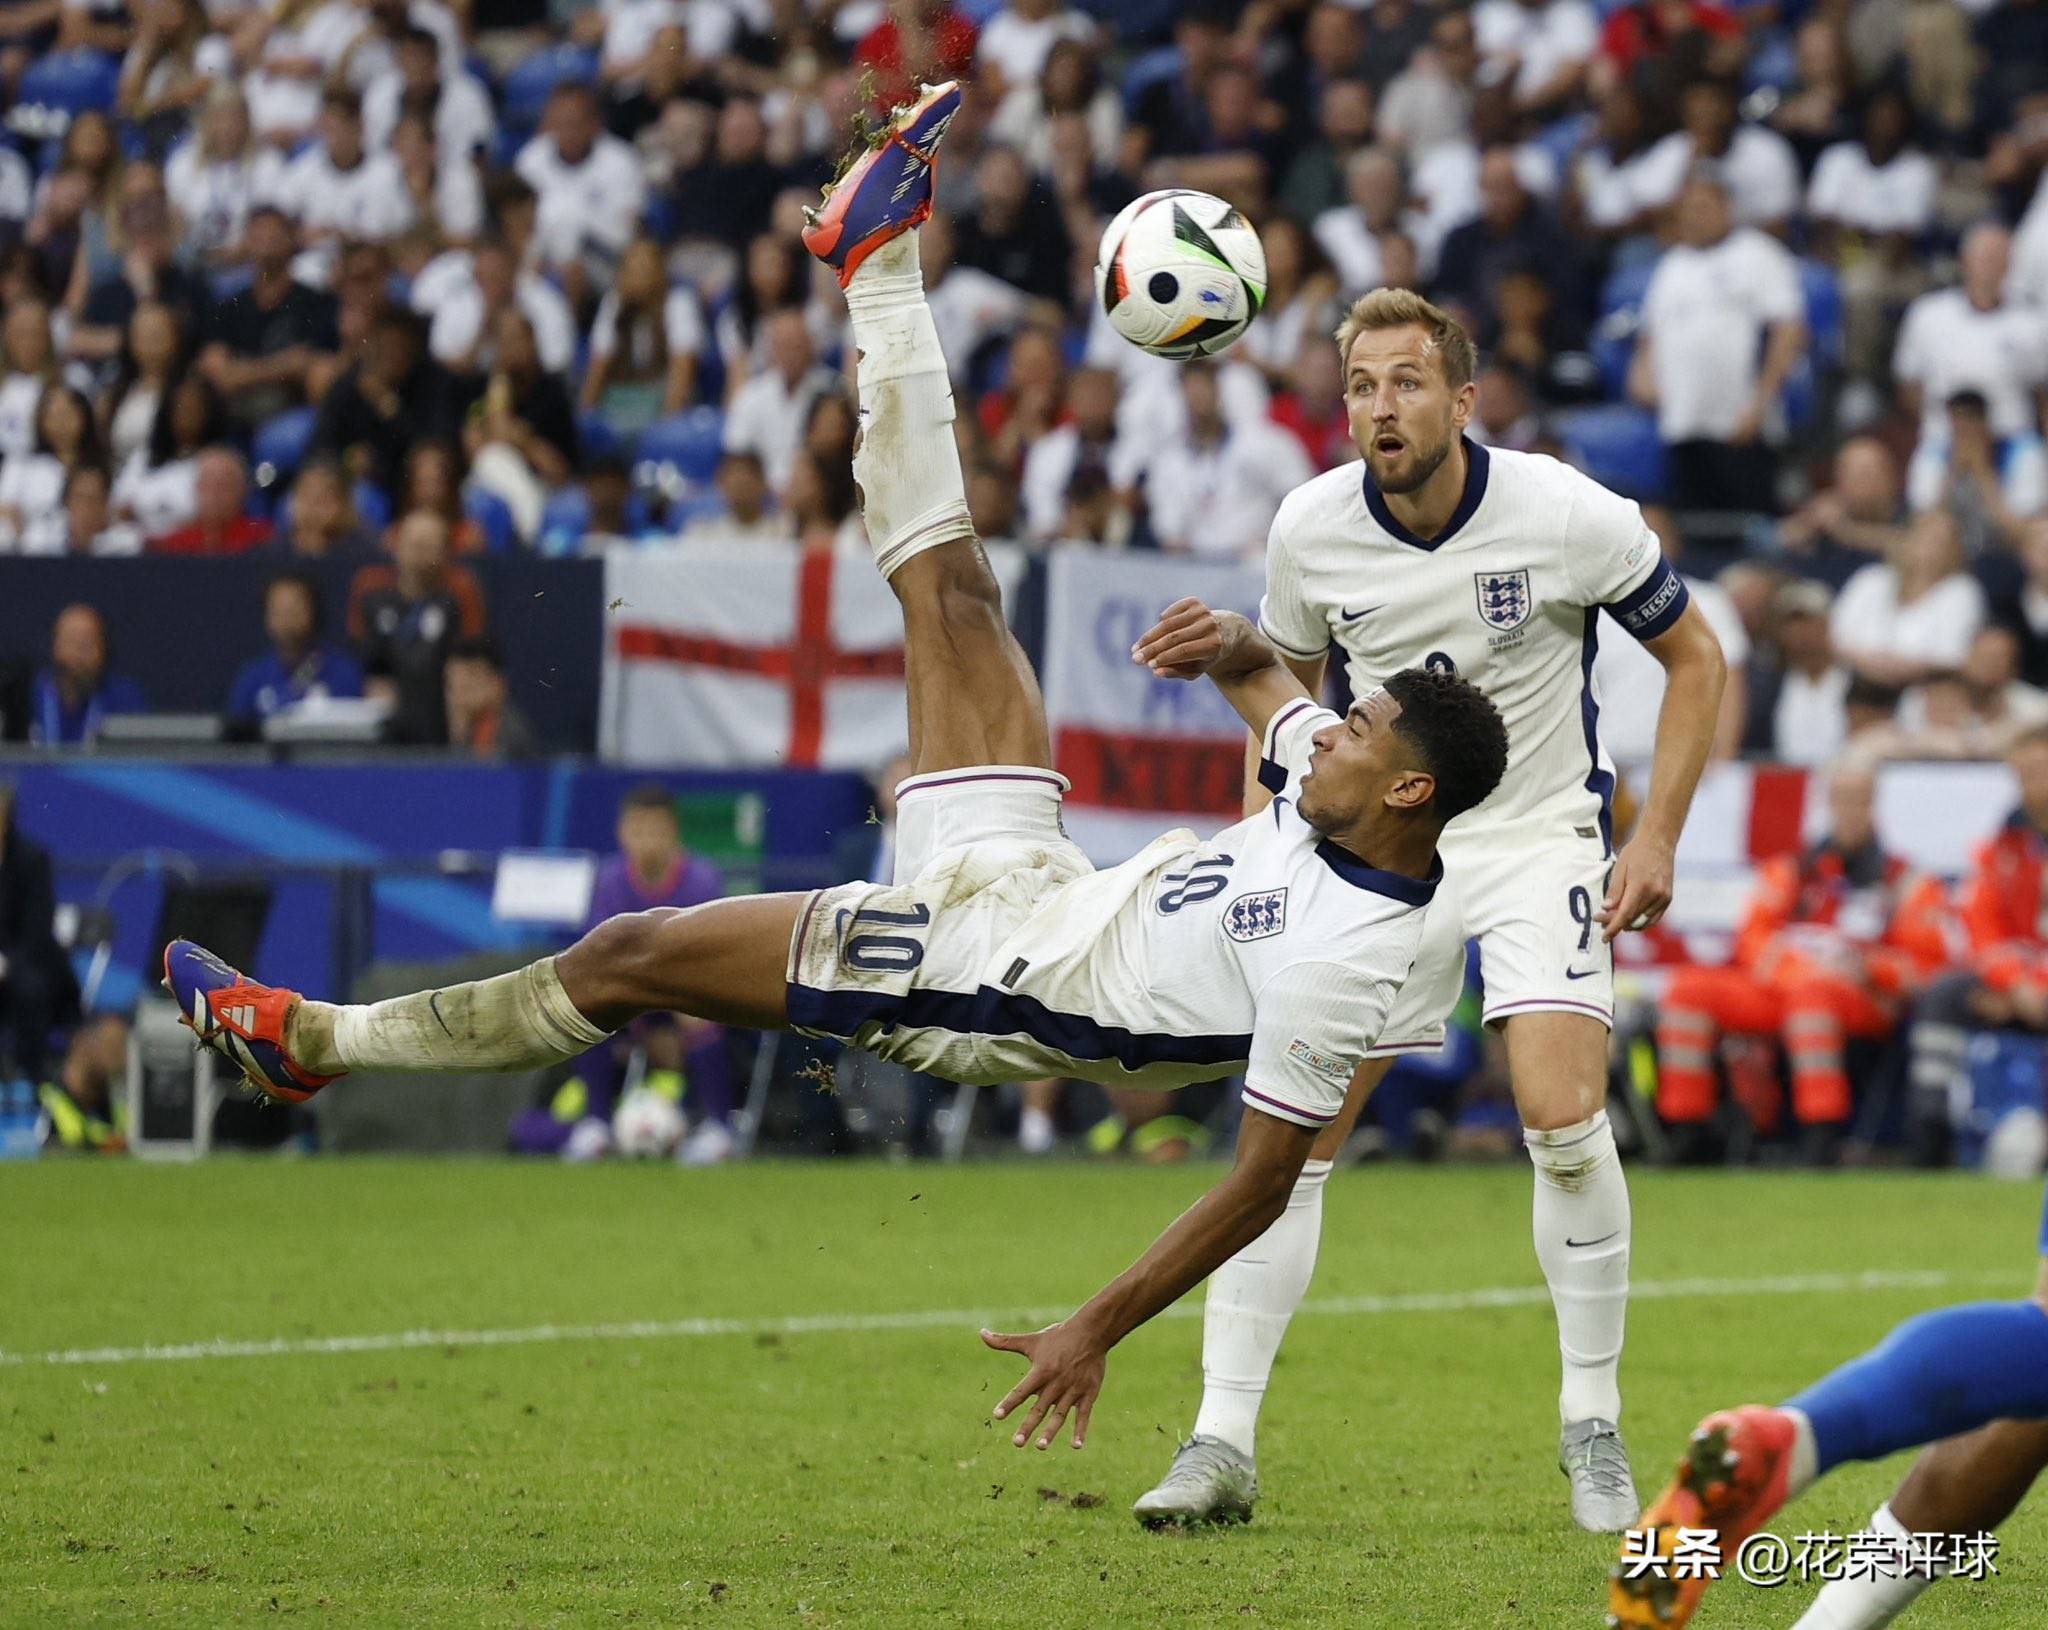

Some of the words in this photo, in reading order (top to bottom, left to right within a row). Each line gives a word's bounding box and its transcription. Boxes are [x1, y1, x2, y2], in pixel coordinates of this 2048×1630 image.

[1641, 573, 1679, 619] RESPECT
[1156, 854, 1234, 916] 10
[845, 903, 930, 973] 10
[1569, 885, 1592, 952] 9
